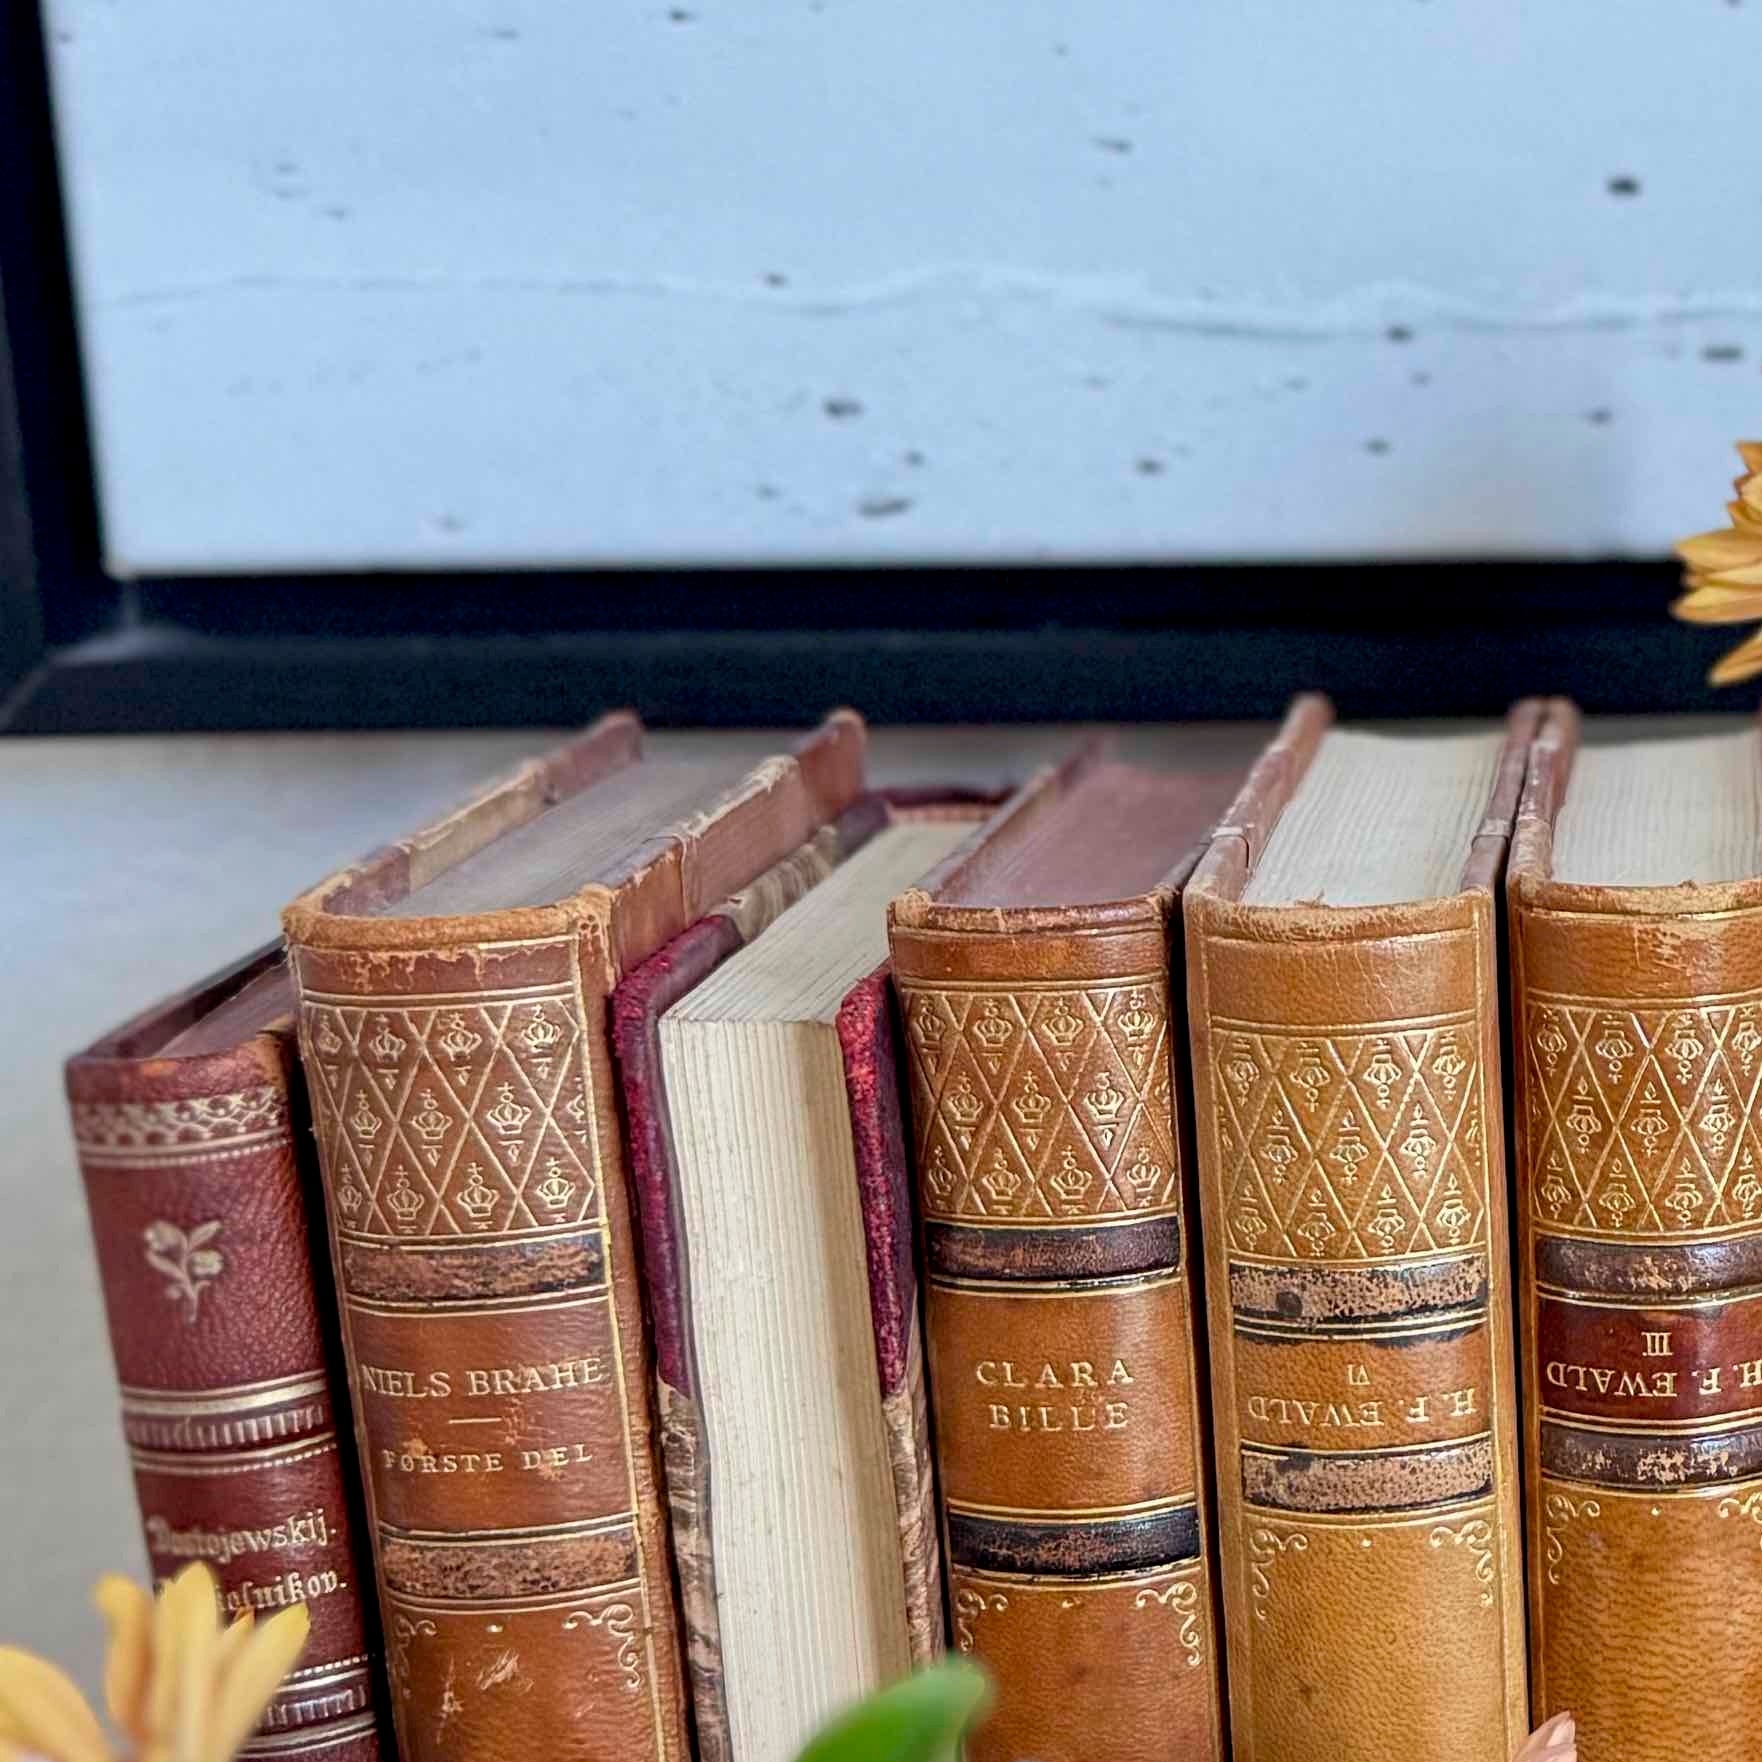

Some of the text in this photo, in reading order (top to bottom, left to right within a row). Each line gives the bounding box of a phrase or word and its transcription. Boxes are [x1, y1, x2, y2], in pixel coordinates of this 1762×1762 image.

[1641, 1331, 1673, 1357] III
[361, 1358, 603, 1398] NIELS BRAHE
[976, 1359, 1135, 1388] CLARA
[1347, 1364, 1370, 1386] VI
[1546, 1362, 1677, 1398] EWALD
[1691, 1367, 1721, 1395] F.
[988, 1402, 1129, 1432] BILLE
[1247, 1388, 1478, 1427] H. F. EWALD
[383, 1443, 594, 1473] FØRSTE DEL
